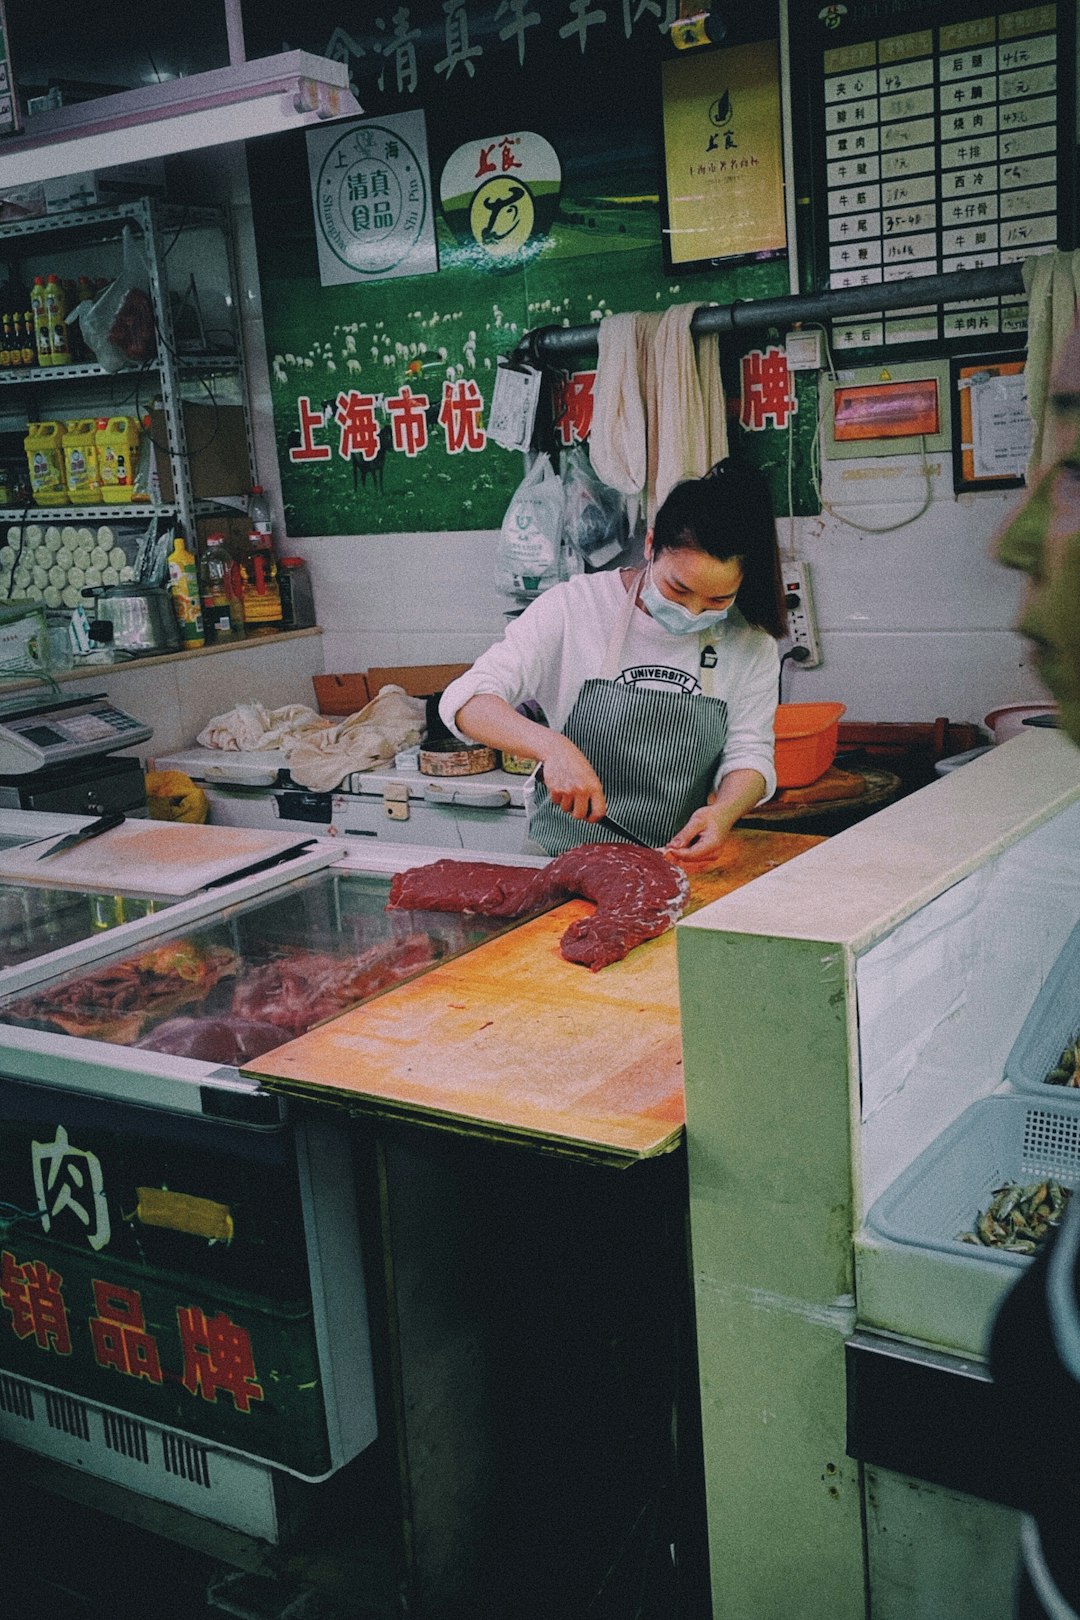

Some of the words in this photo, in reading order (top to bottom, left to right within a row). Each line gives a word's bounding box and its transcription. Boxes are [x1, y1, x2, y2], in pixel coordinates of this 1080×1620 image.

[836, 79, 864, 96] 夹心
[957, 144, 982, 160] 牛排
[347, 169, 391, 201] 清真
[954, 172, 985, 189] 西冷
[352, 201, 394, 232] 食品
[952, 202, 988, 220] 牛仔骨
[839, 219, 868, 236] 牛尾
[955, 231, 987, 248] 牛脚
[954, 315, 989, 332] 羊肉片
[630, 668, 690, 685] UNIVERSITY
[31, 1125, 112, 1251] 肉
[0, 1250, 265, 1414] 销品牌
